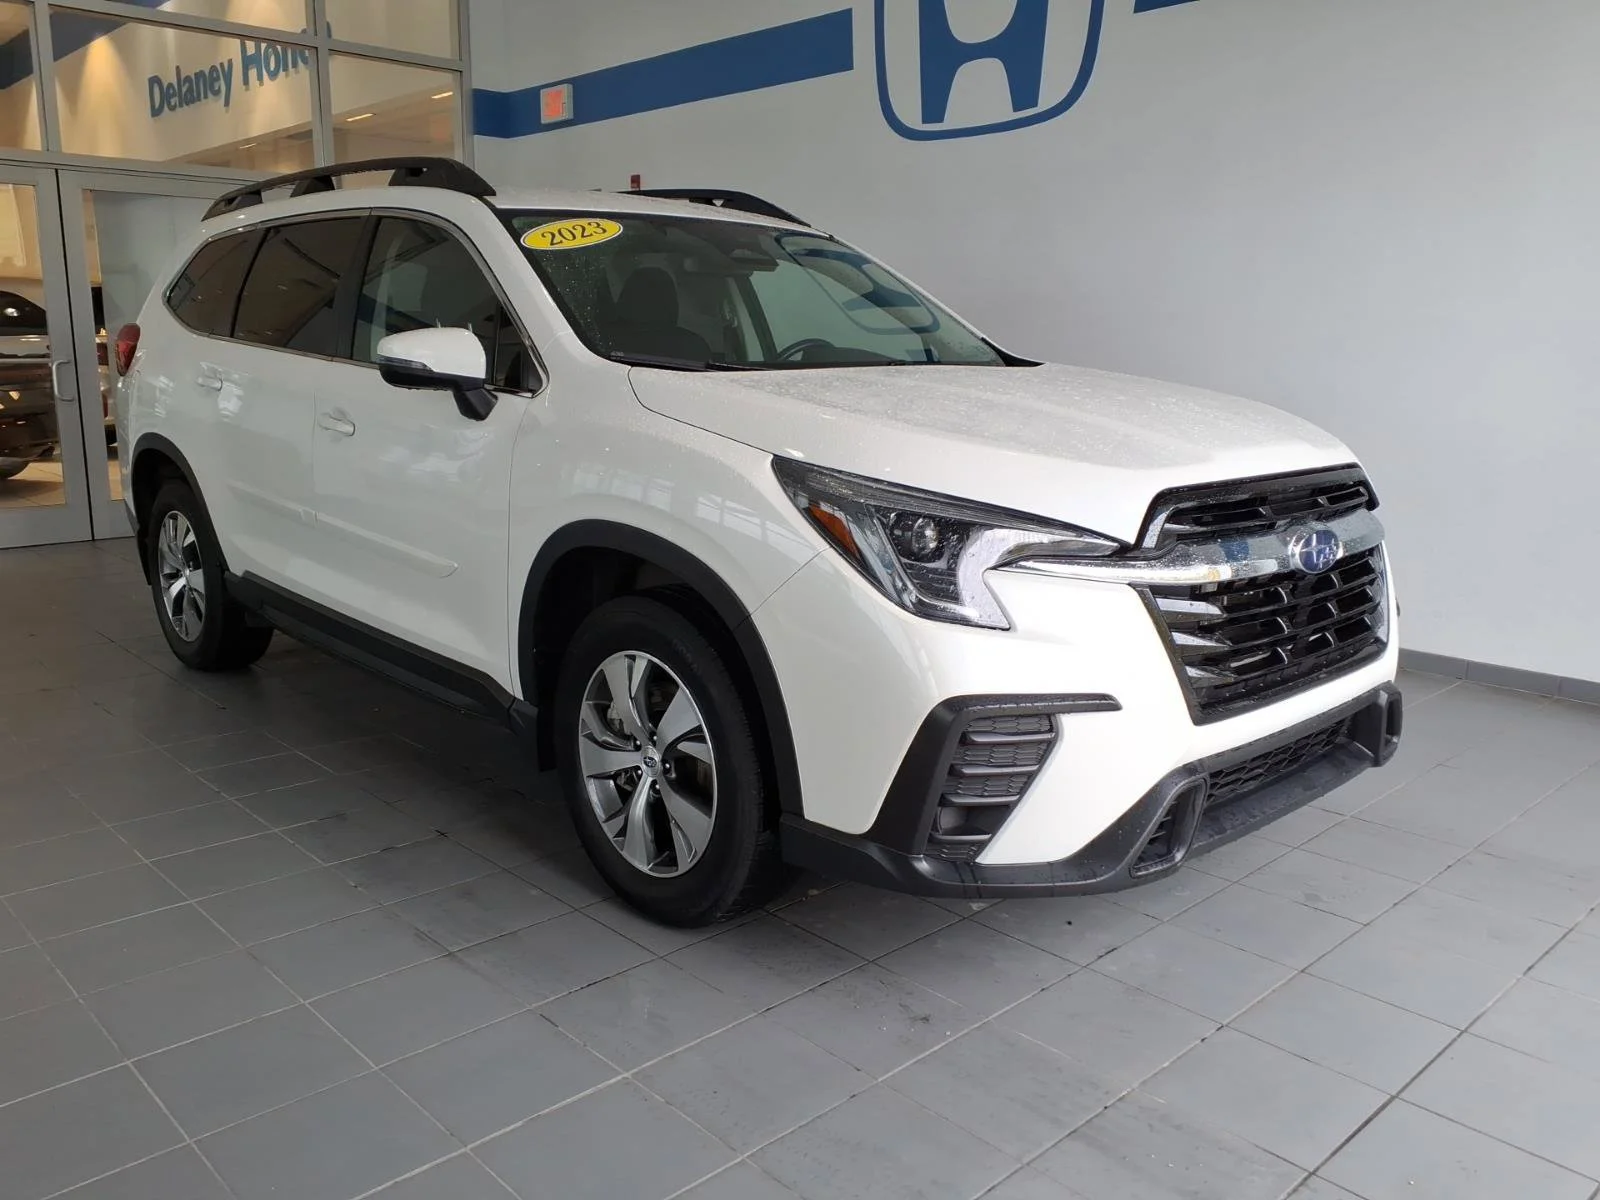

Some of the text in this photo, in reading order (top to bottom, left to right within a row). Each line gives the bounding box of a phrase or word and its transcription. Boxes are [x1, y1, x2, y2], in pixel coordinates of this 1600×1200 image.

[148, 22, 331, 118] Delaney Hon
[541, 220, 607, 246] 2023
